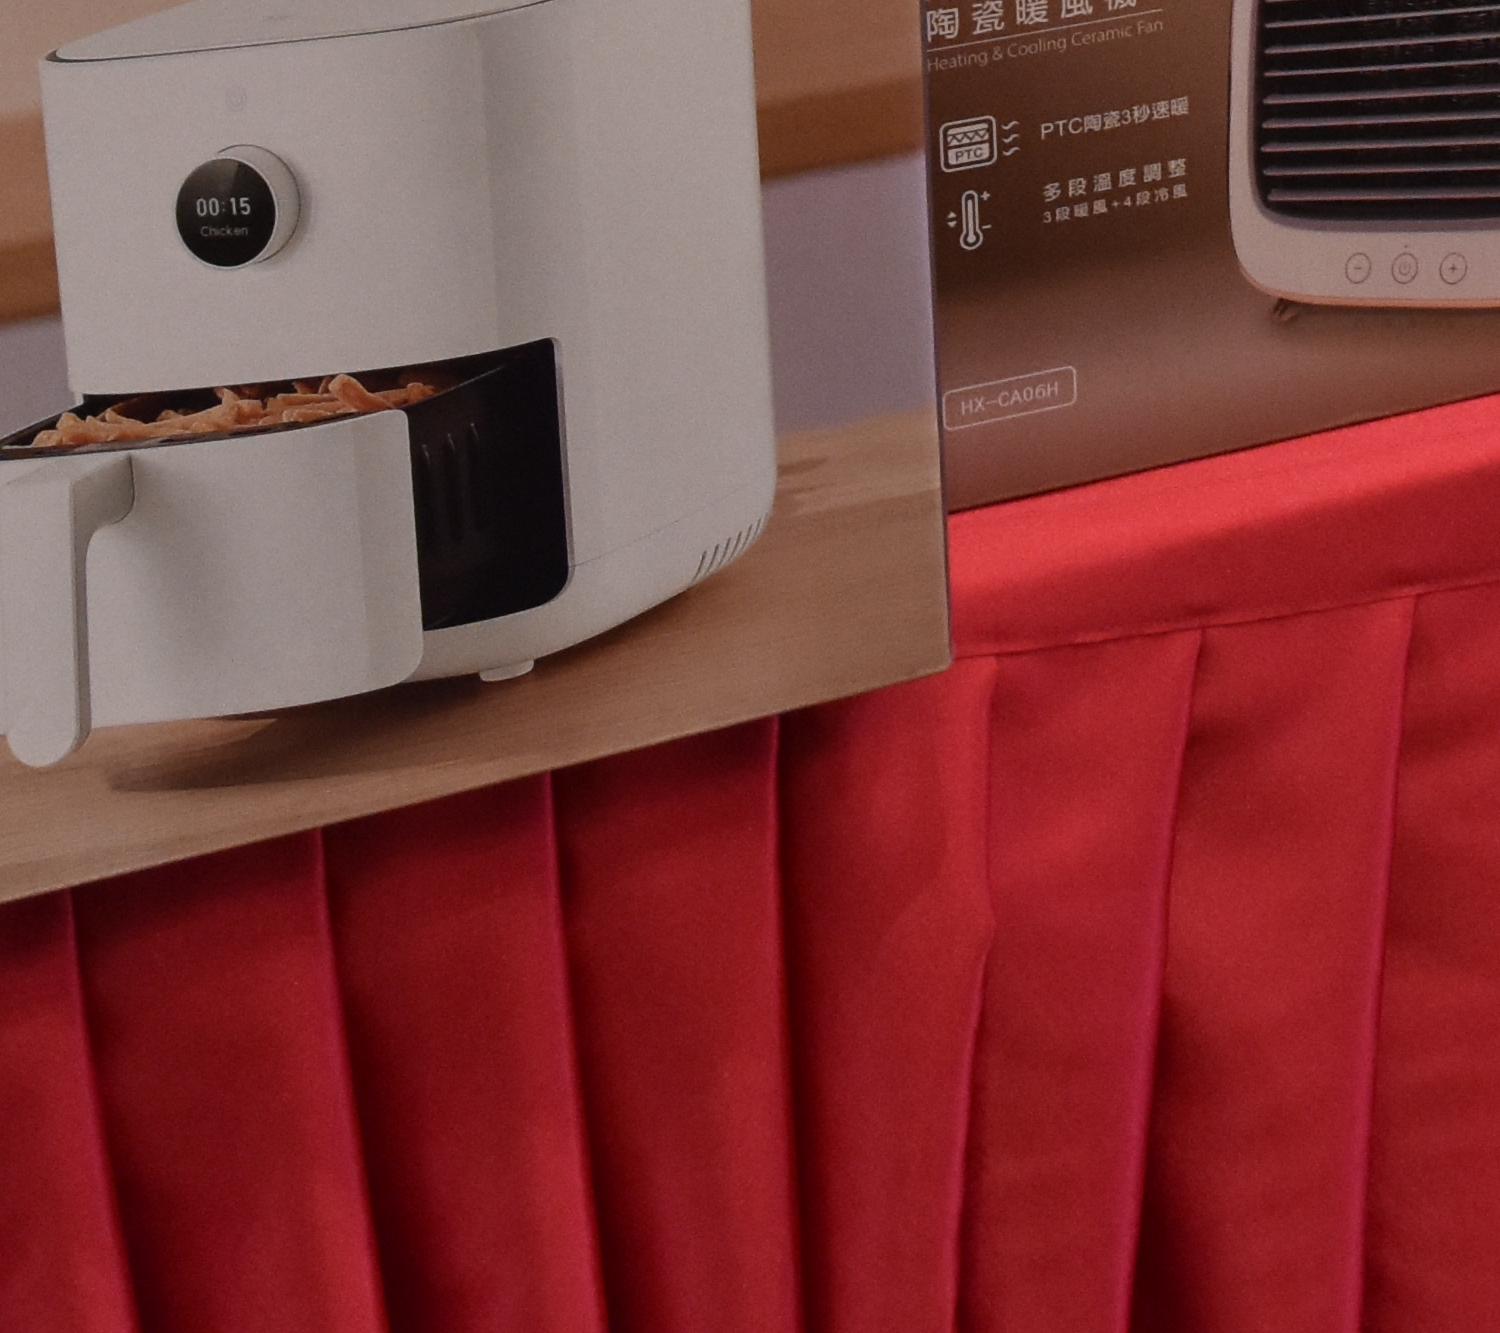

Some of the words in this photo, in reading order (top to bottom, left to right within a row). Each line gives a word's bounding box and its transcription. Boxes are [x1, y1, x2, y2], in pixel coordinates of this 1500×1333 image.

[927, 50, 988, 73] Heating
[992, 46, 1003, 61] &
[1007, 35, 1067, 58] Cooling
[1071, 25, 1132, 46] Ceramic
[1137, 18, 1163, 34] Fan
[1040, 96, 1190, 140] PTC陶瓷3秒速暖
[955, 146, 983, 162] PTC
[1043, 158, 1187, 203] 多段溫度調整
[196, 197, 250, 216] 00:15
[200, 225, 248, 237] Chicken
